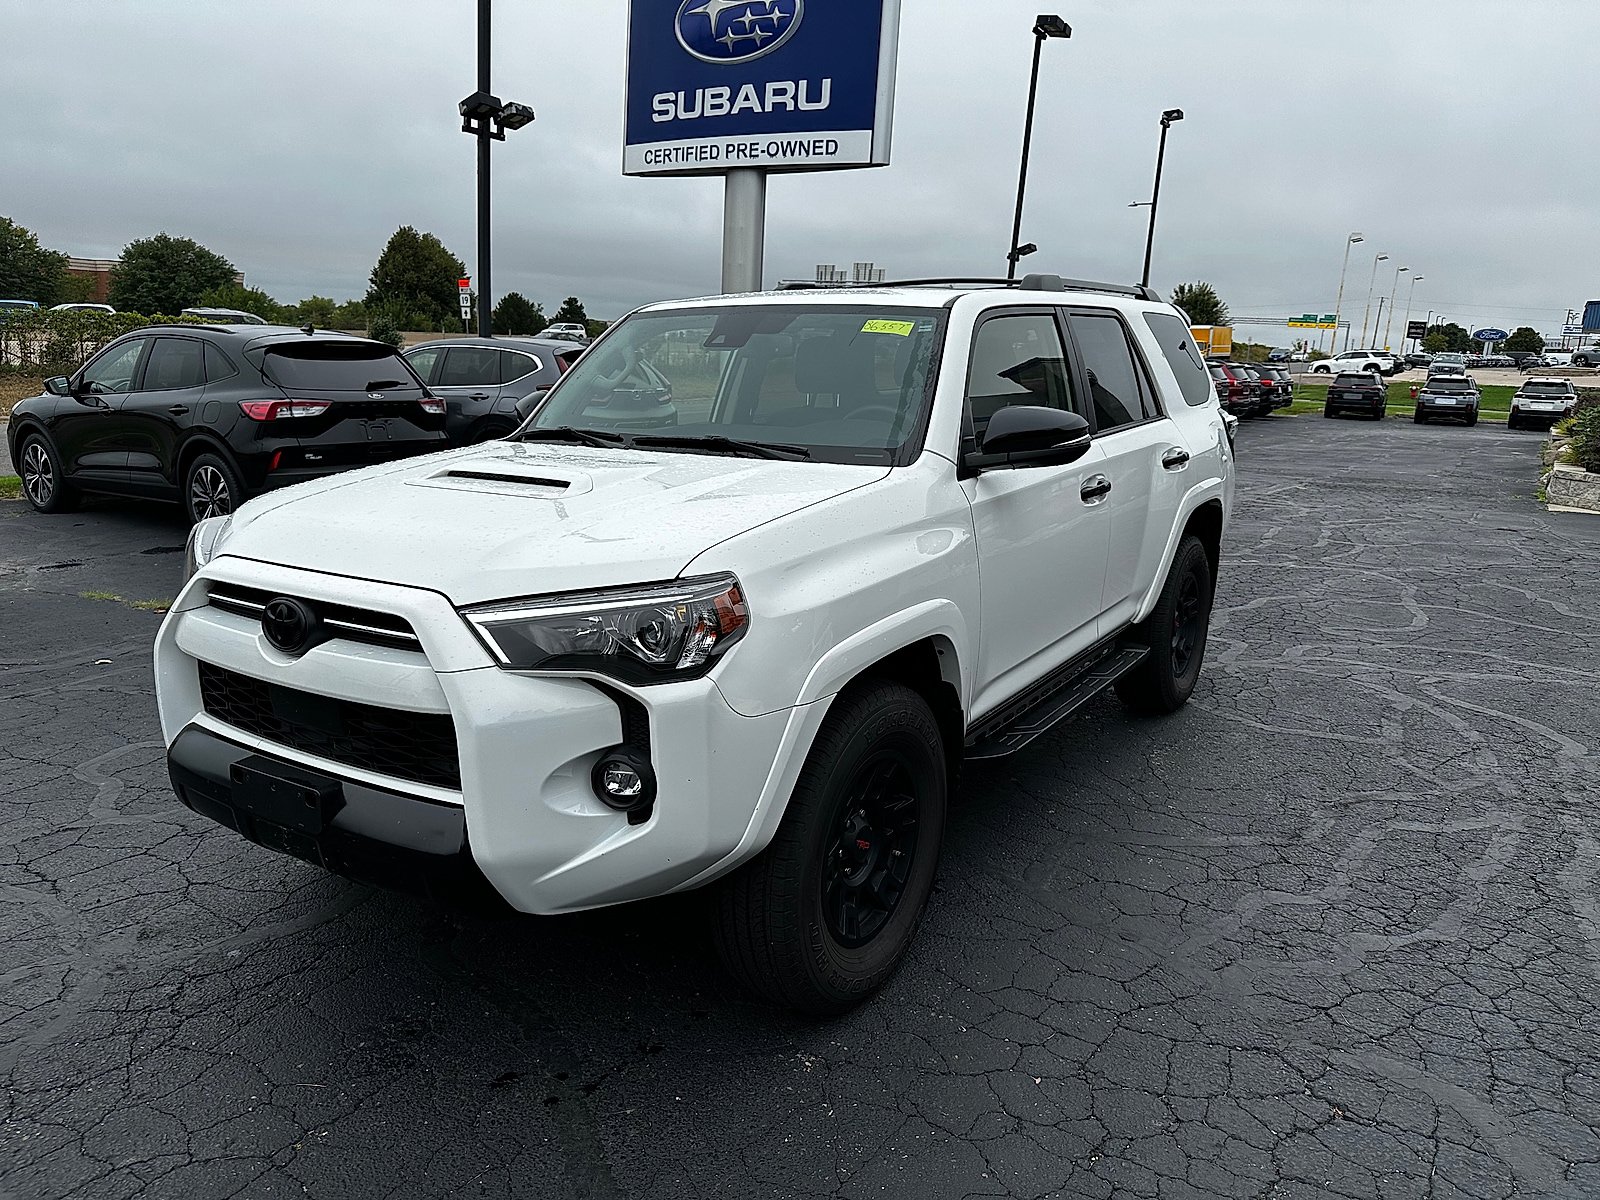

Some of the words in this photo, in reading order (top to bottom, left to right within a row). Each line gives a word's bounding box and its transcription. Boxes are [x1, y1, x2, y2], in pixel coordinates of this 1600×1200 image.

[652, 78, 832, 123] SUBARU
[644, 144, 720, 165] CERTIFIED
[725, 139, 839, 160] PRE-OWNED
[461, 296, 469, 304] 19
[1479, 329, 1501, 339] Ford
